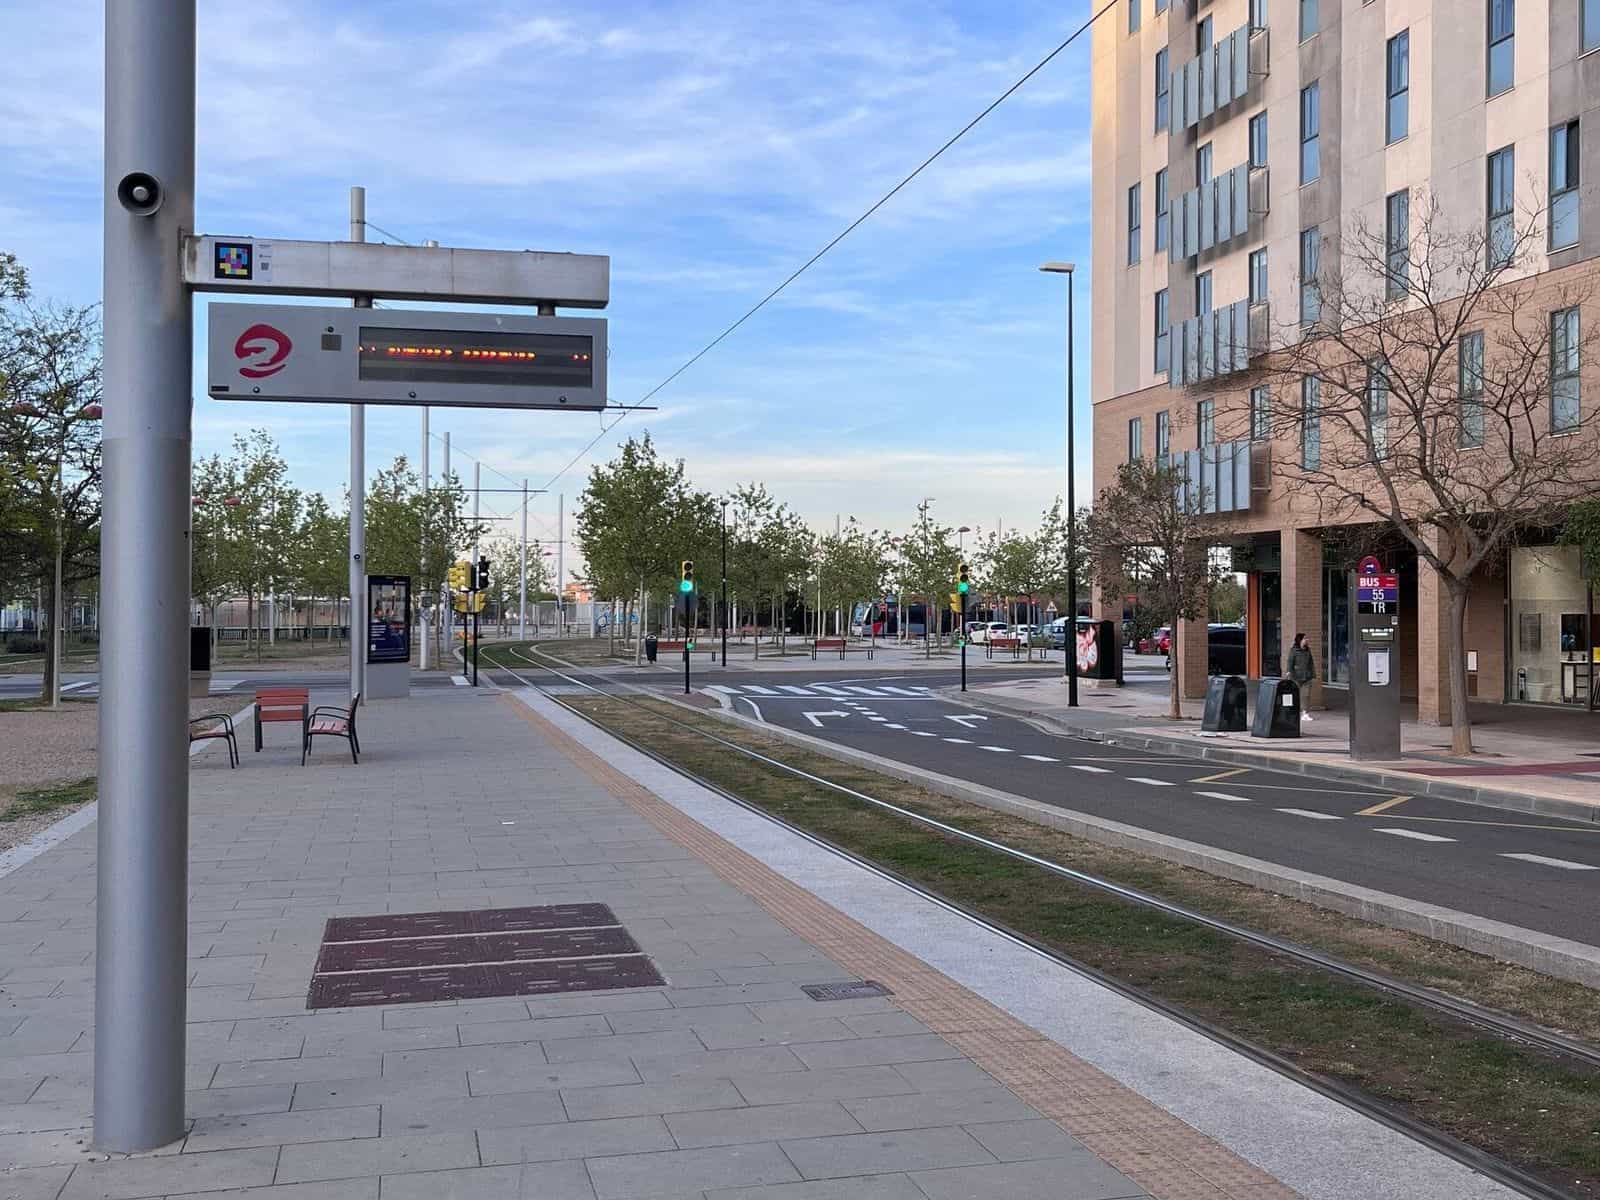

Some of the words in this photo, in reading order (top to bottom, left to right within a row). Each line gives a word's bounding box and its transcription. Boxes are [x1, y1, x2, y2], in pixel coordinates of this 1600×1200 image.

[1359, 577, 1380, 587] BUS
[1372, 588, 1385, 600] 55
[1371, 601, 1386, 614] TR
